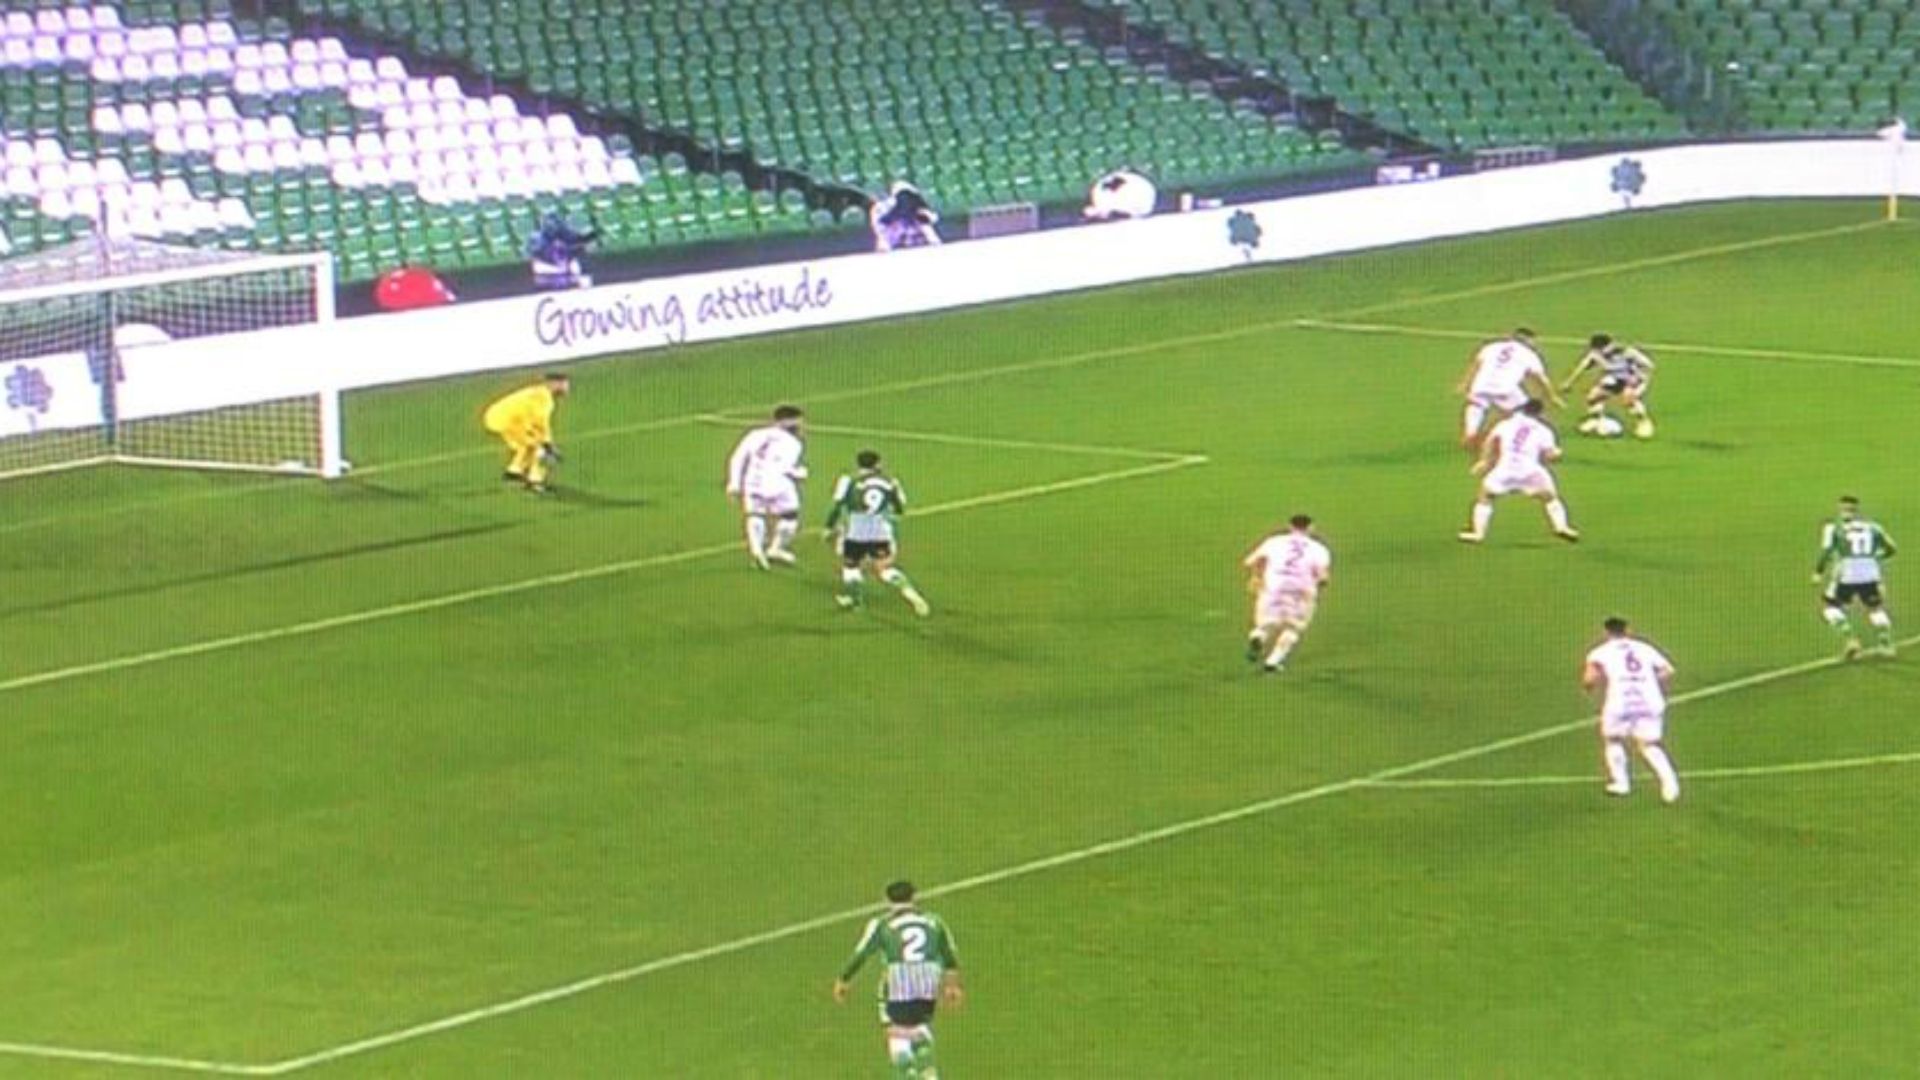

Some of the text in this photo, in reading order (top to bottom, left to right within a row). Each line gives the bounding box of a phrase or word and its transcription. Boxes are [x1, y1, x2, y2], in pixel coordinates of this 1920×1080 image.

[535, 266, 832, 345] Growing attitude
[863, 487, 885, 515] 9
[1846, 530, 1872, 555] 11
[1625, 650, 1643, 673] 6
[901, 925, 927, 962] 2
